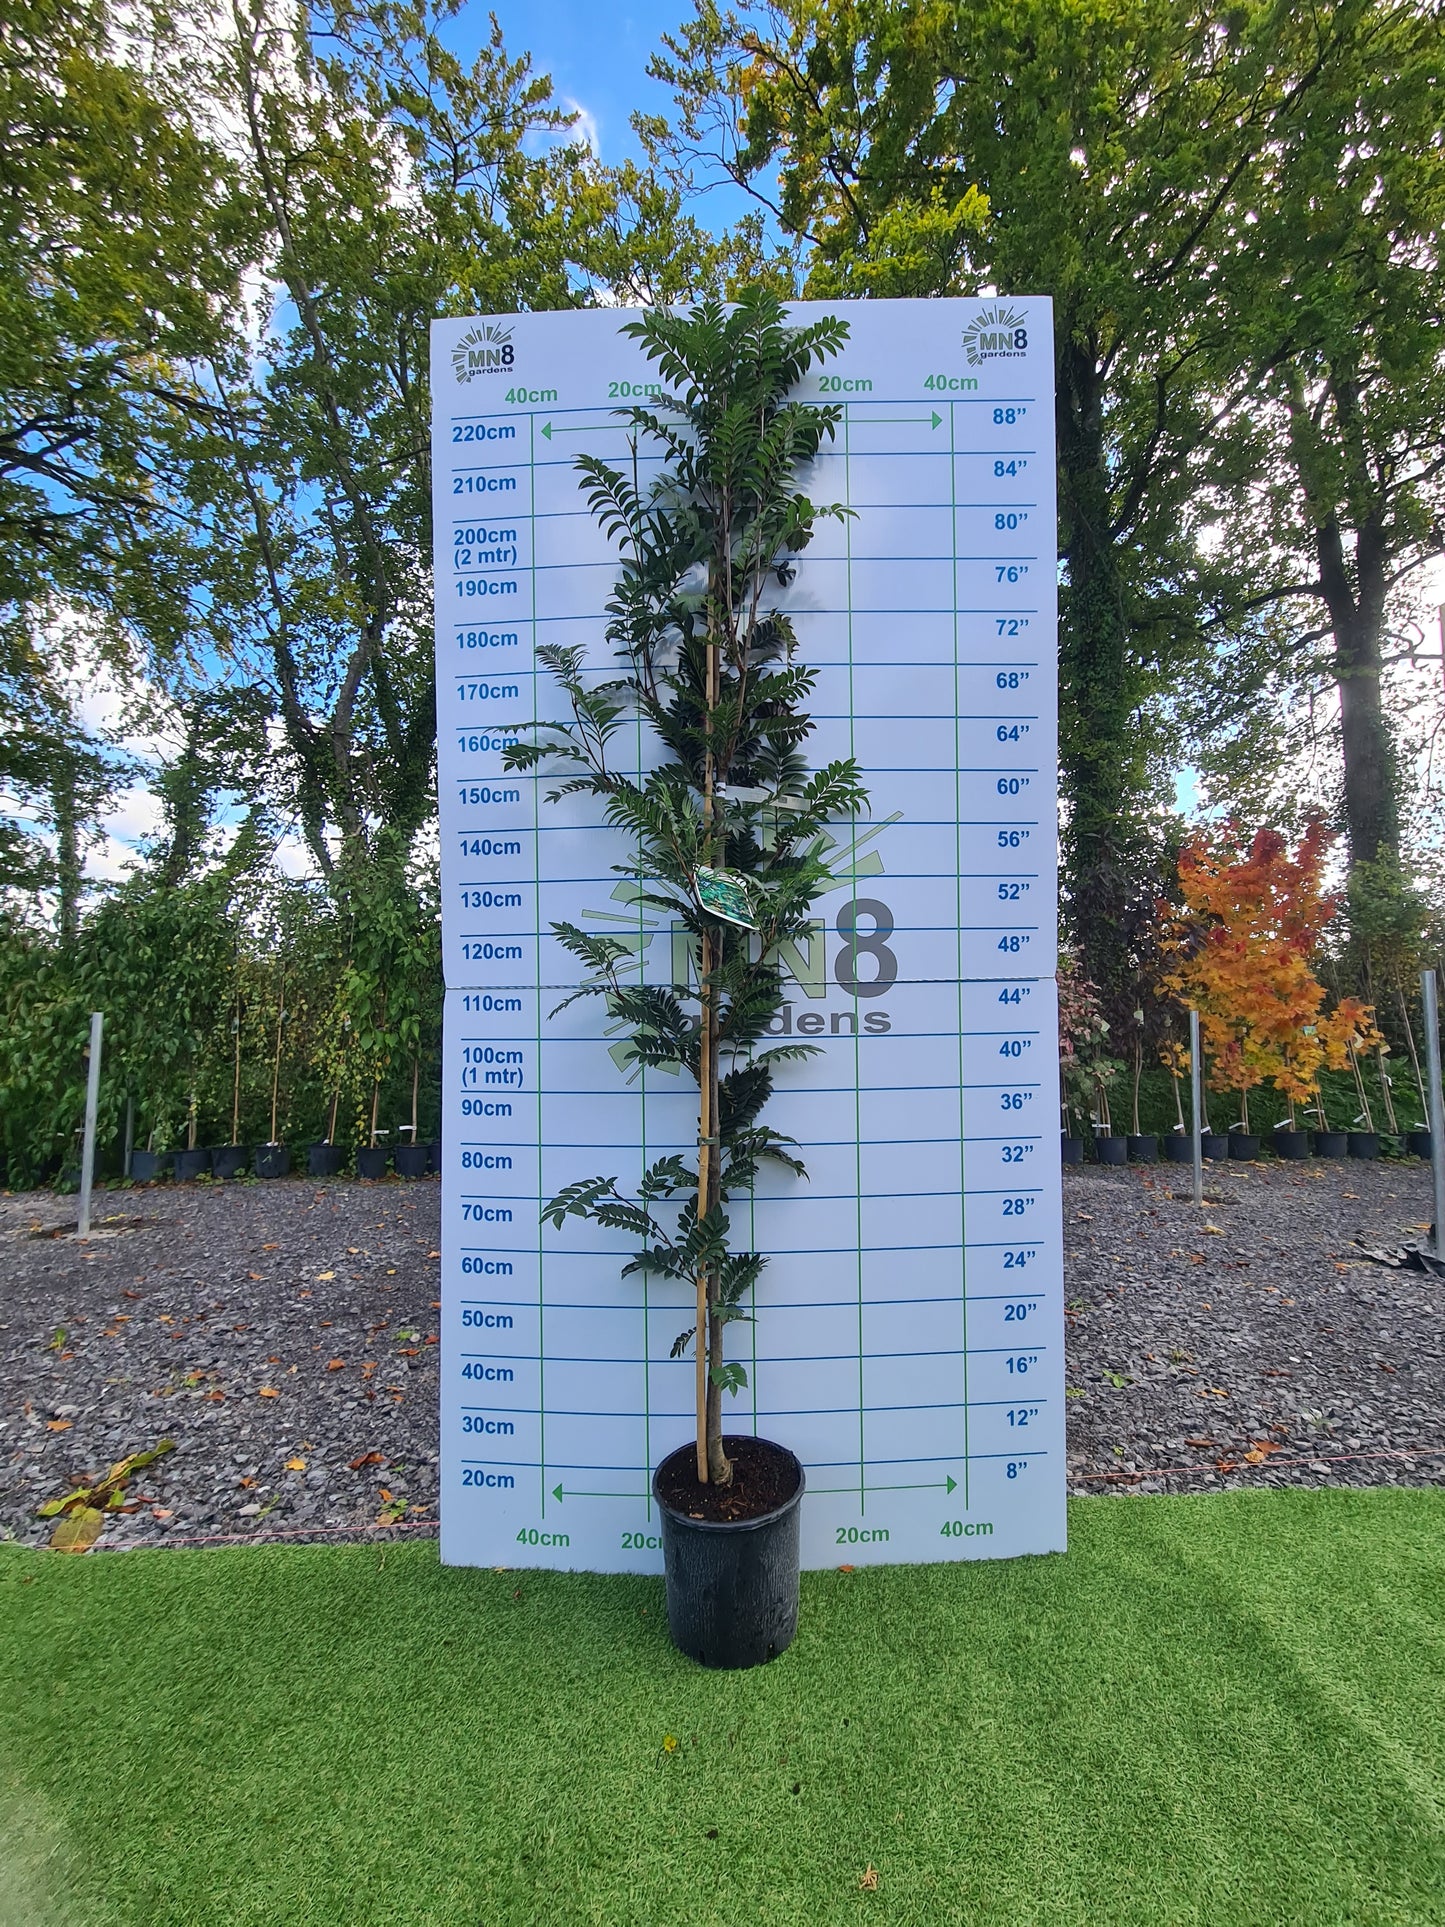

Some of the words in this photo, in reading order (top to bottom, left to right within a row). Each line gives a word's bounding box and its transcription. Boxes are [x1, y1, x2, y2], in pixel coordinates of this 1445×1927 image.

[980, 328, 1028, 350] MN8
[469, 344, 515, 368] MN8
[980, 350, 1026, 359] gardens
[469, 366, 513, 376] gardens
[608, 381, 662, 398] 20cm
[819, 376, 873, 392] 20cm
[923, 374, 978, 391] 40cm
[505, 387, 558, 404] 40cm
[452, 424, 516, 443] 220cm
[452, 475, 517, 495] 210cm
[453, 526, 518, 546] 200cm
[454, 548, 472, 570] (2
[478, 545, 517, 566] mtr)
[455, 579, 518, 598] 190cm
[456, 631, 519, 649] 180cm
[457, 683, 519, 701] 170cm
[457, 734, 520, 753] 160cm
[458, 787, 520, 805] 150cm
[459, 838, 521, 857] 140cm
[460, 890, 522, 908] 130cm
[462, 943, 523, 961] 120cm
[462, 994, 523, 1012] 110cm
[676, 1005, 893, 1040] dens
[462, 1046, 524, 1064] 100cm
[462, 1066, 477, 1088] (1
[485, 1067, 524, 1089] mtr)
[461, 1098, 512, 1117] 90cm
[461, 1151, 513, 1170] 80cm
[461, 1204, 513, 1223] 70cm
[461, 1256, 513, 1276] 60cm
[462, 1309, 513, 1329] 50cm
[461, 1362, 514, 1382] 40cm
[462, 1415, 515, 1435] 30cm
[462, 1469, 515, 1489] 20cm
[516, 1527, 570, 1547] 40cm
[835, 1527, 890, 1544] 20cm
[940, 1520, 994, 1537] 40cm
